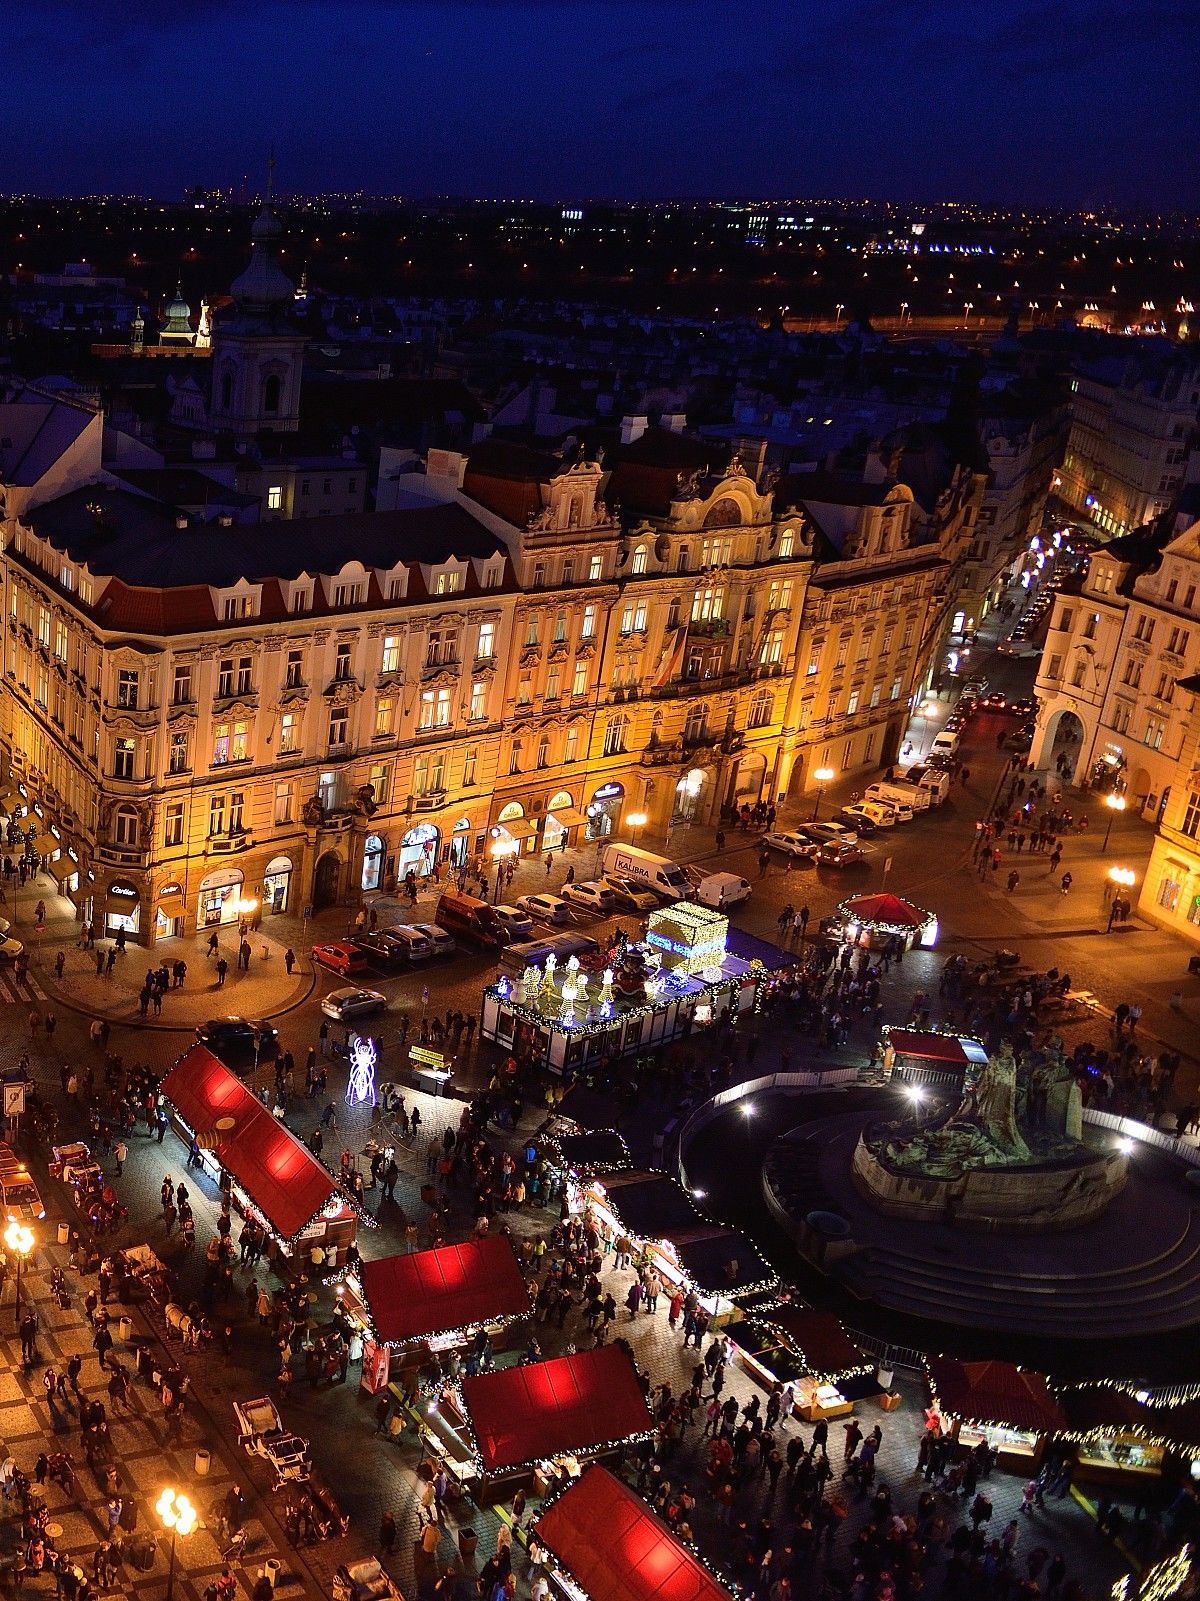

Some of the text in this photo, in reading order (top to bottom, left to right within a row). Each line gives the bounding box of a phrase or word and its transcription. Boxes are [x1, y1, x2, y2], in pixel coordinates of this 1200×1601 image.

[618, 860, 649, 878] KALIBRA
[111, 885, 136, 897] Cartier
[160, 886, 179, 895] Cartier
